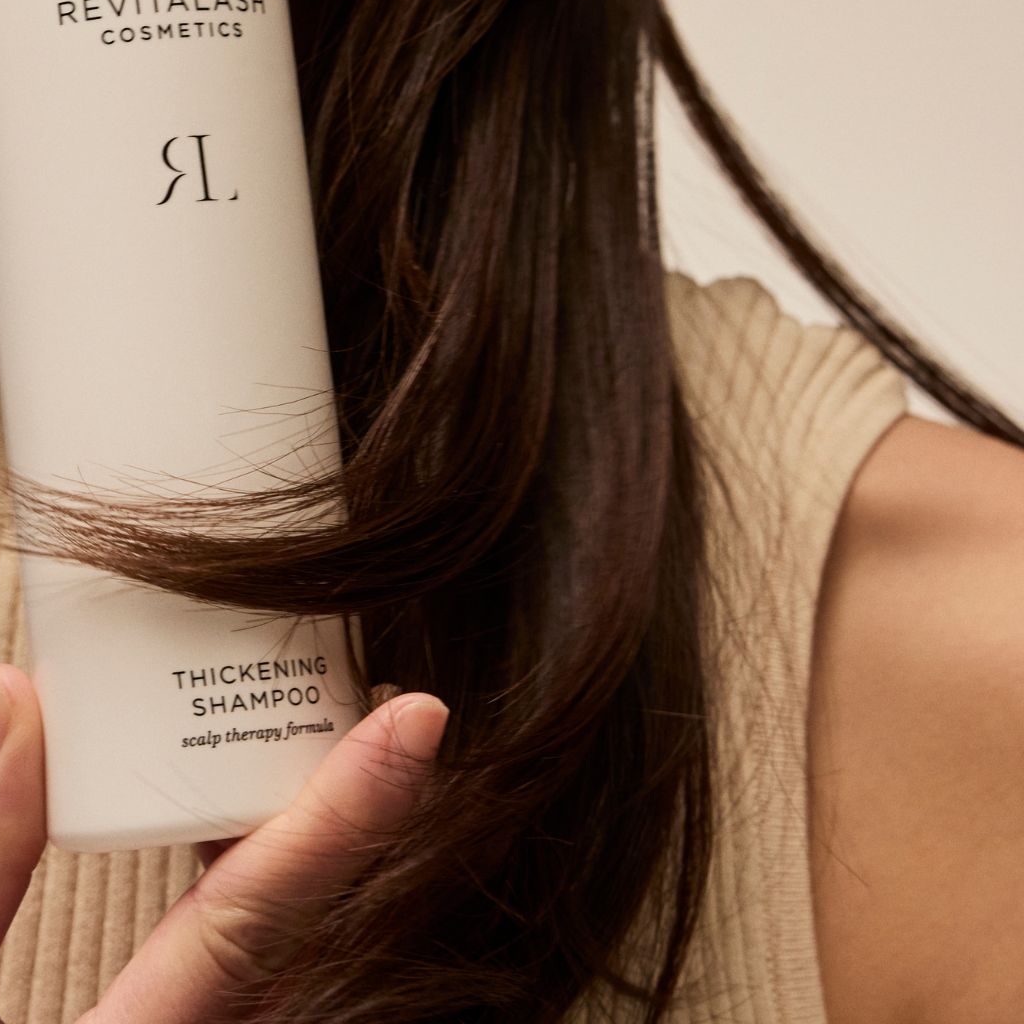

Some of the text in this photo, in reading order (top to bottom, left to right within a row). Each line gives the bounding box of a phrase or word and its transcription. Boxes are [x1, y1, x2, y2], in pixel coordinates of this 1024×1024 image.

[101, 21, 243, 45] COSMETICS
[172, 656, 328, 689] THICKENING
[192, 686, 320, 716] SHAMPOO
[181, 718, 335, 748] scalp therapy formula
